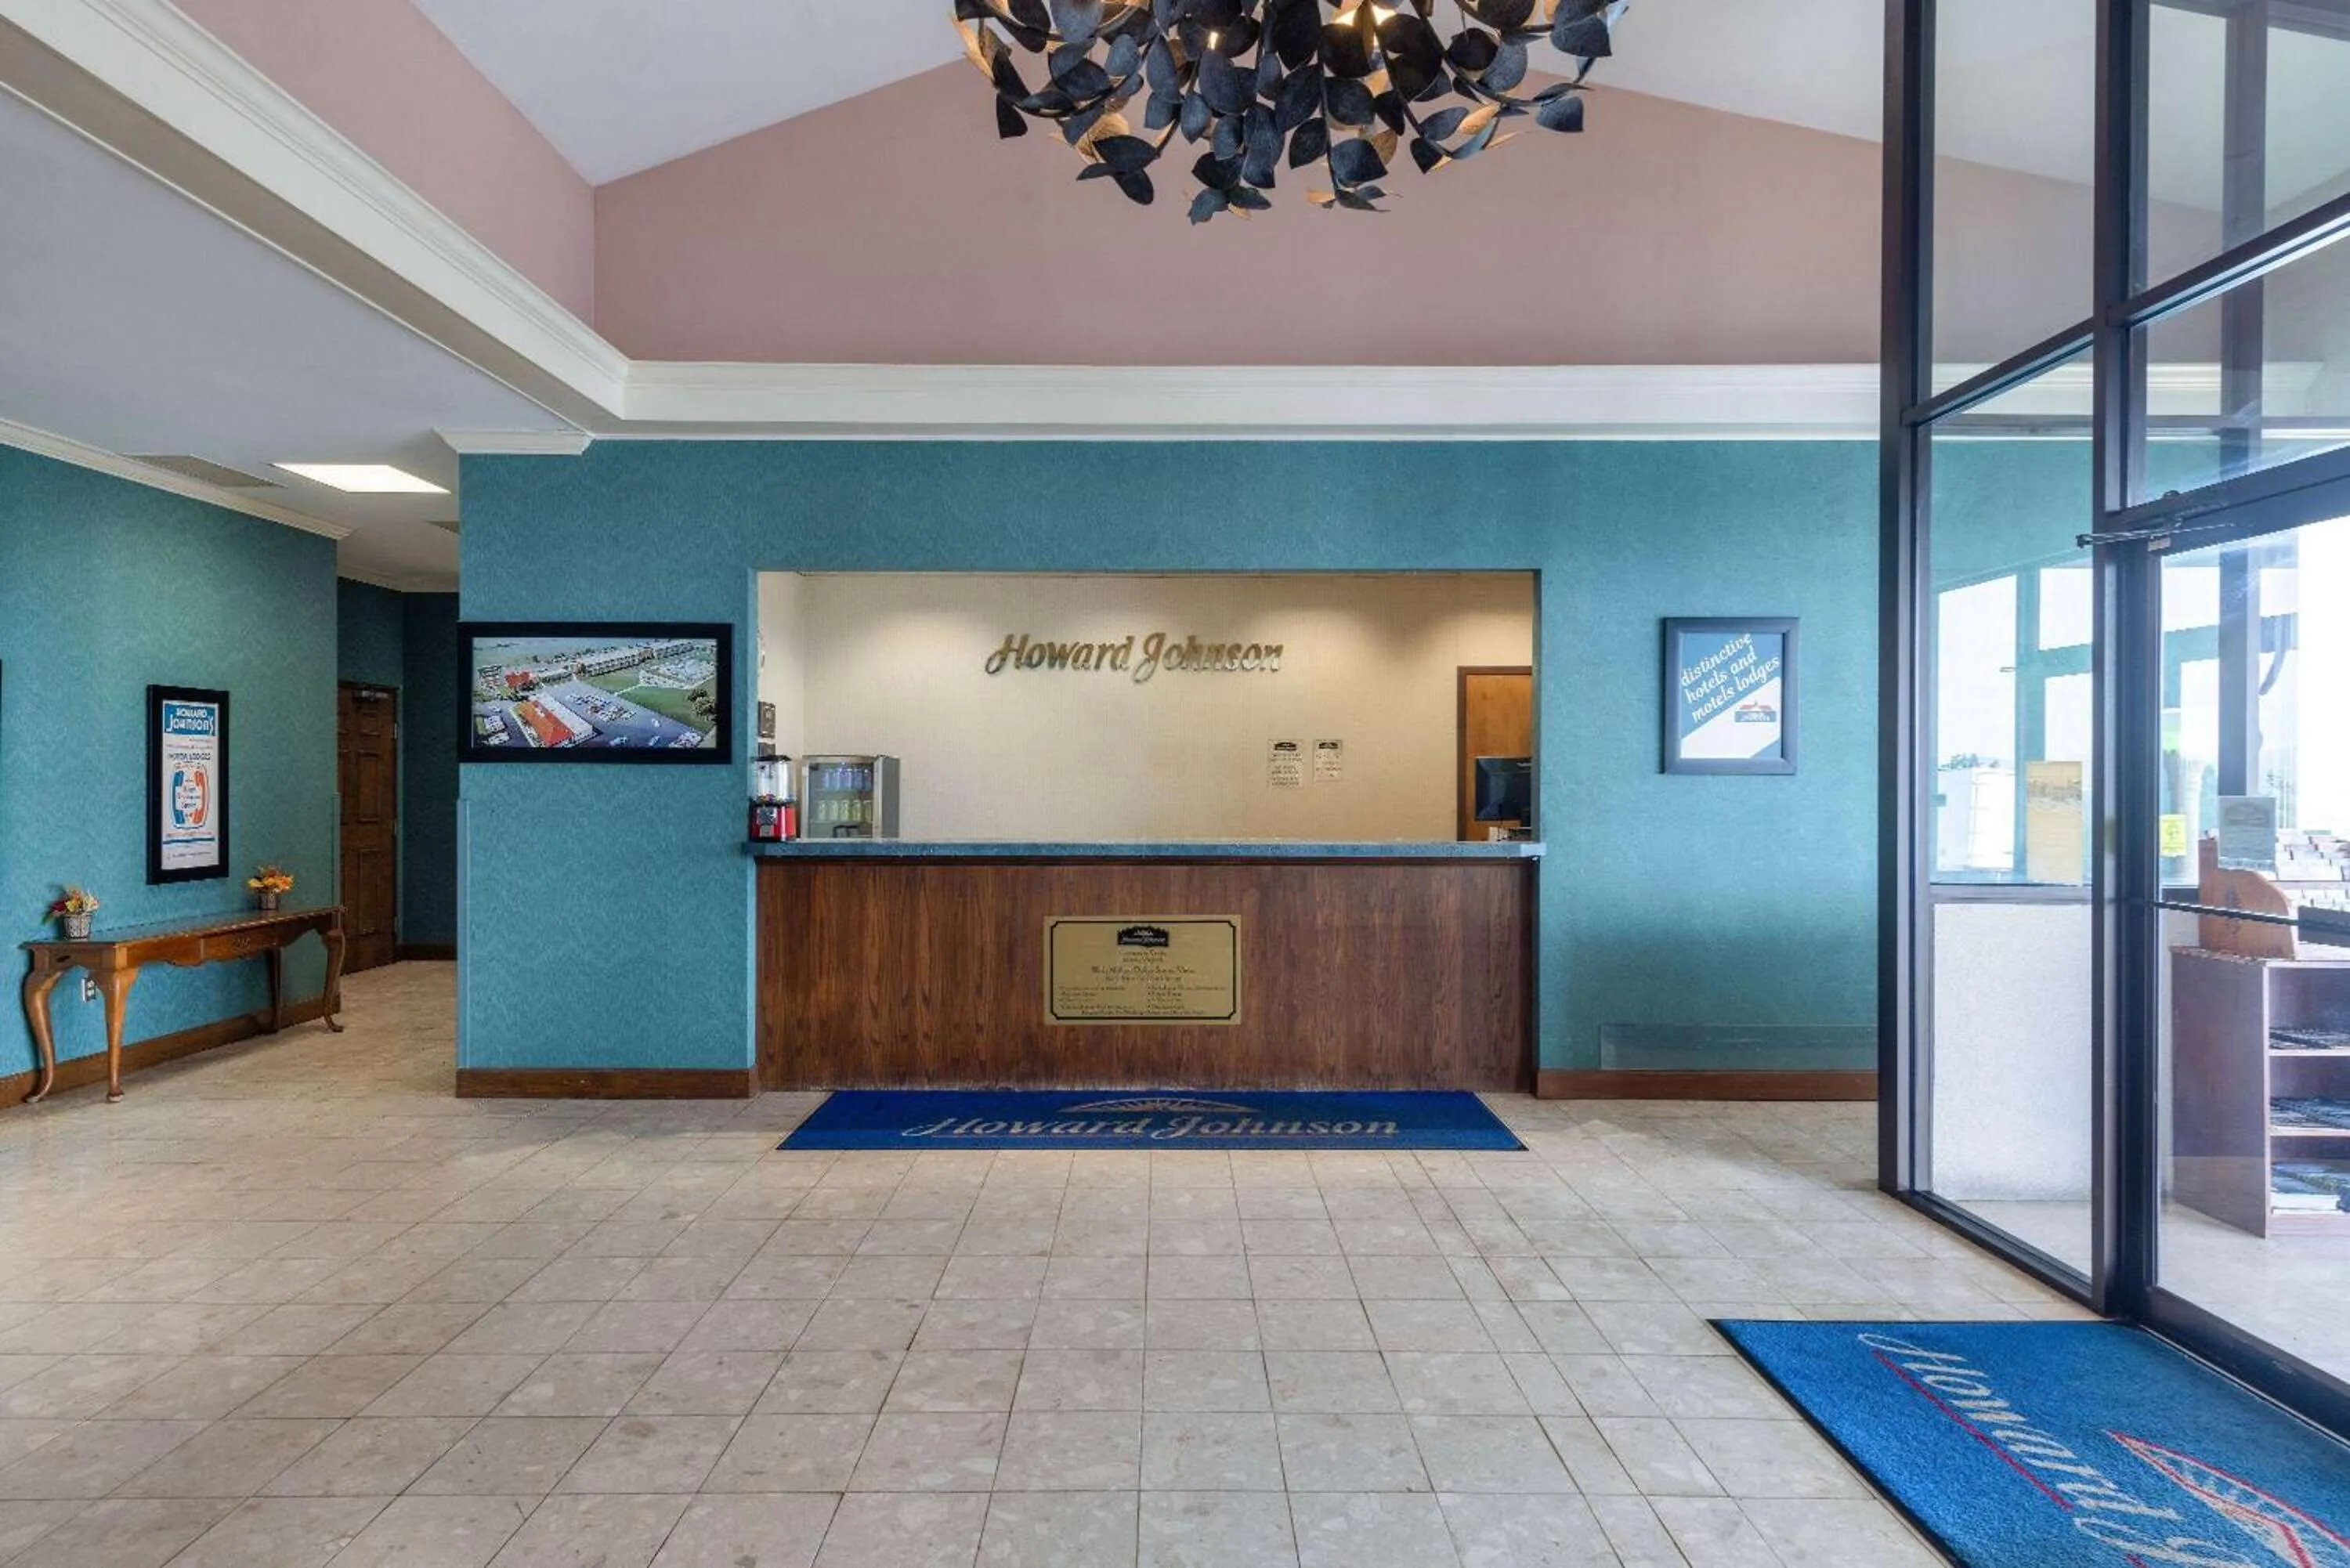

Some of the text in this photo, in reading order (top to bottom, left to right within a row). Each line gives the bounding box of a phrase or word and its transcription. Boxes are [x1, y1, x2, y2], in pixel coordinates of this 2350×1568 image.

[985, 631, 1284, 684] Howard Johnson
[1682, 634, 1752, 686] distinctive
[1685, 645, 1757, 704] hotels and
[1692, 656, 1780, 722] motels lodges
[902, 1115, 1400, 1140] Howard Johnson
[1856, 1331, 2184, 1520] Howard
